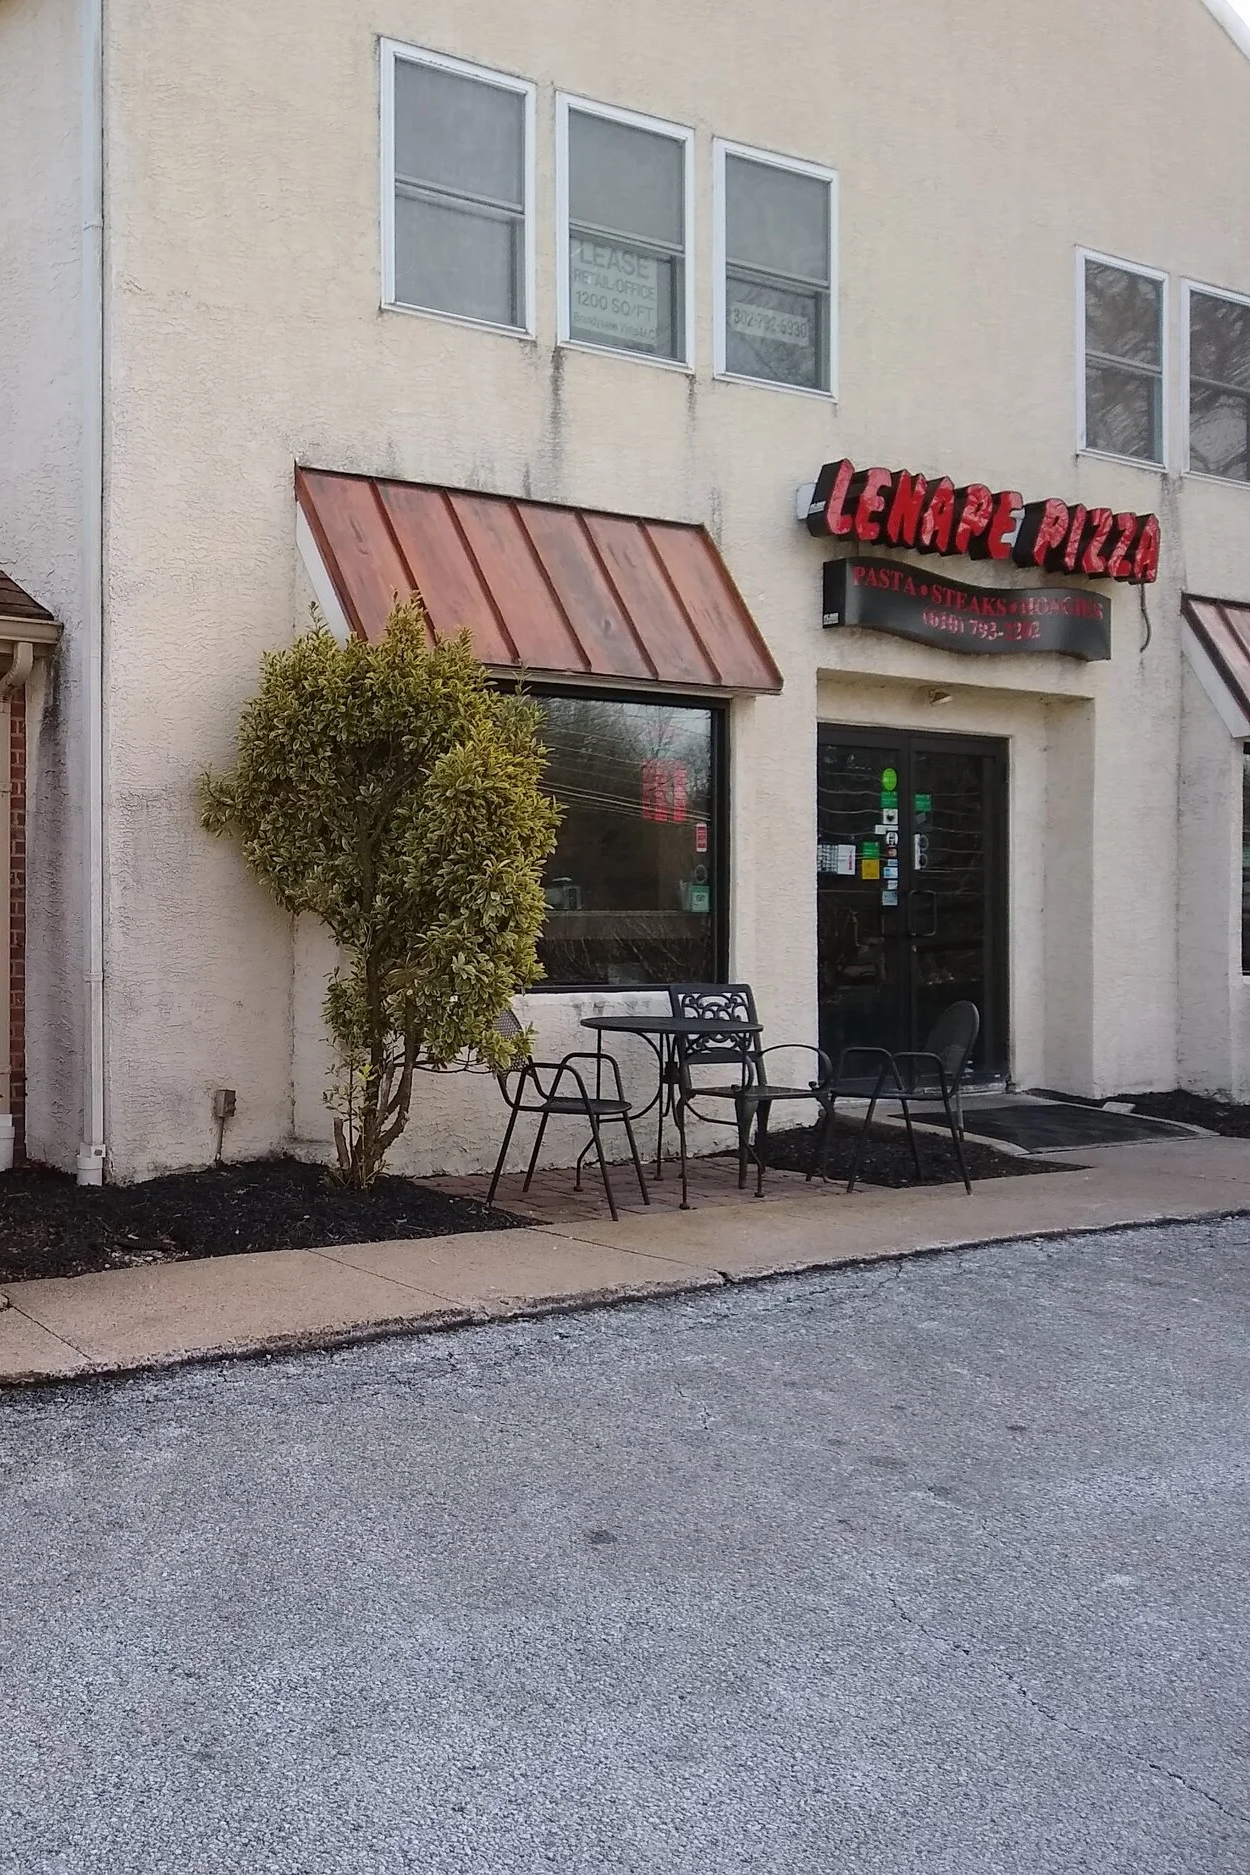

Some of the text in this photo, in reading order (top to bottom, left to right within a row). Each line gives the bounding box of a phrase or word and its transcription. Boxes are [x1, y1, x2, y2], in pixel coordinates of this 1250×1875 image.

[579, 240, 649, 280] LEASE
[576, 290, 608, 311] 1200
[826, 457, 1162, 584] LENAPE PIZZA
[852, 564, 918, 598] PASTA
[931, 584, 1008, 617] STEAKS
